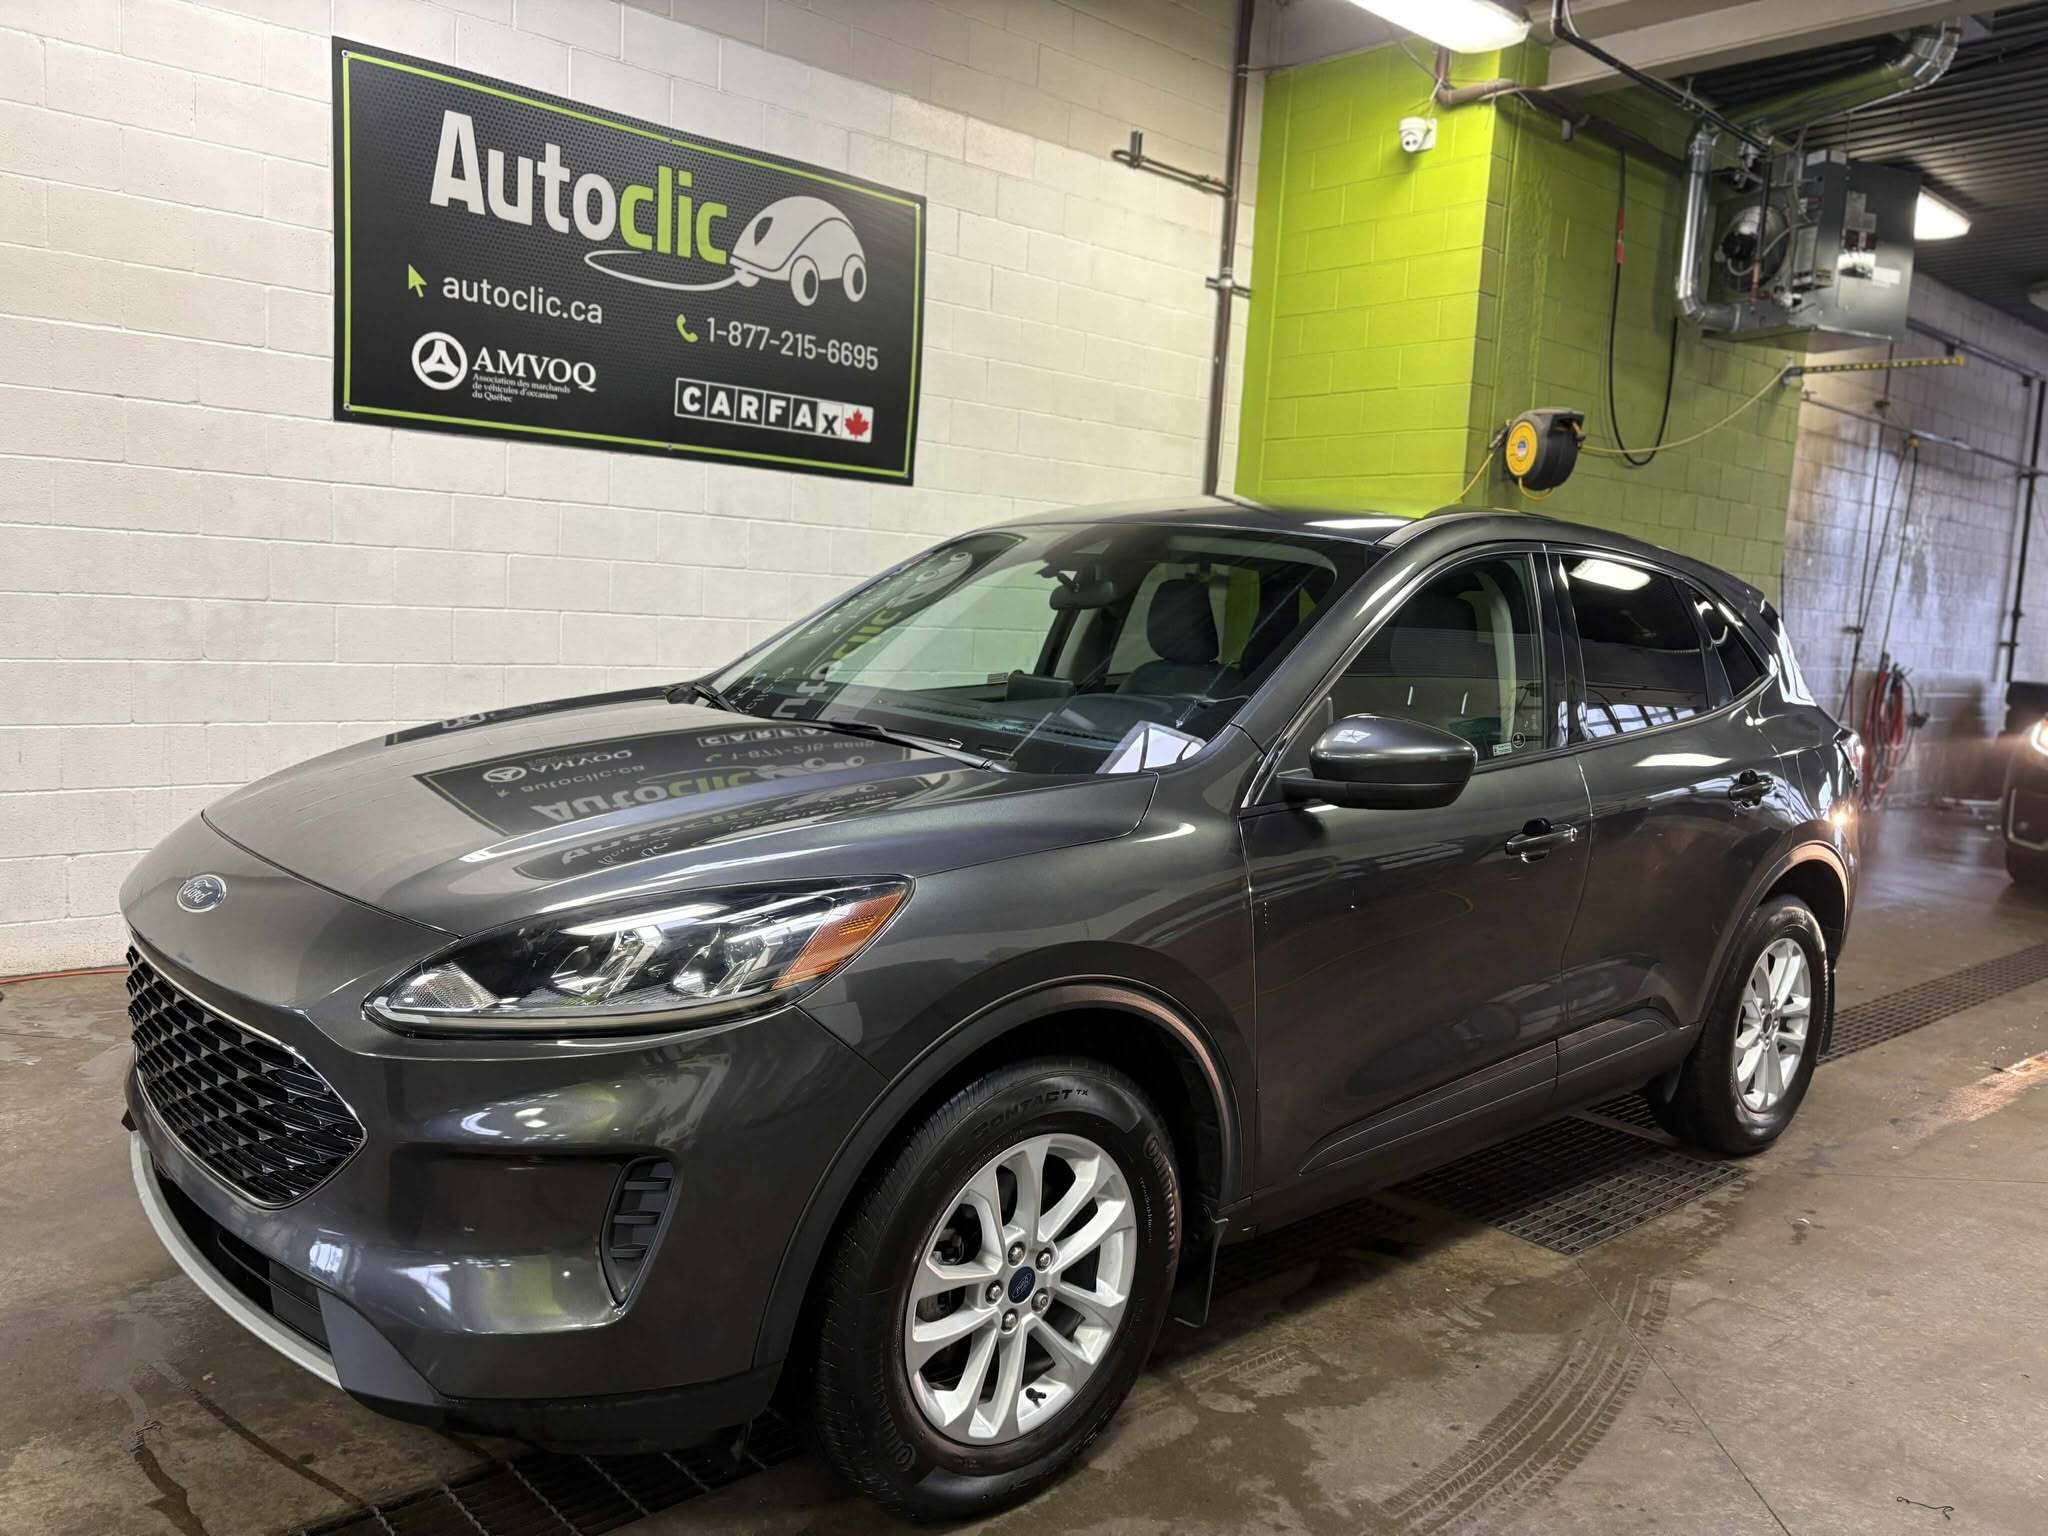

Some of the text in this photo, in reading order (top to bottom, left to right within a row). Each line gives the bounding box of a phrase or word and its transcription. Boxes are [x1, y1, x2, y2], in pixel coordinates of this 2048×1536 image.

[430, 109, 728, 265] Autoclic
[442, 276, 603, 324] autoclic.ca
[706, 316, 879, 371] 1-877-215-6695
[472, 346, 597, 393] AMVOQ
[472, 373, 571, 394] Association des marchands
[472, 381, 558, 400] de véhicules d'occasion
[472, 391, 513, 403] du Québec
[682, 386, 838, 435] CARFAX
